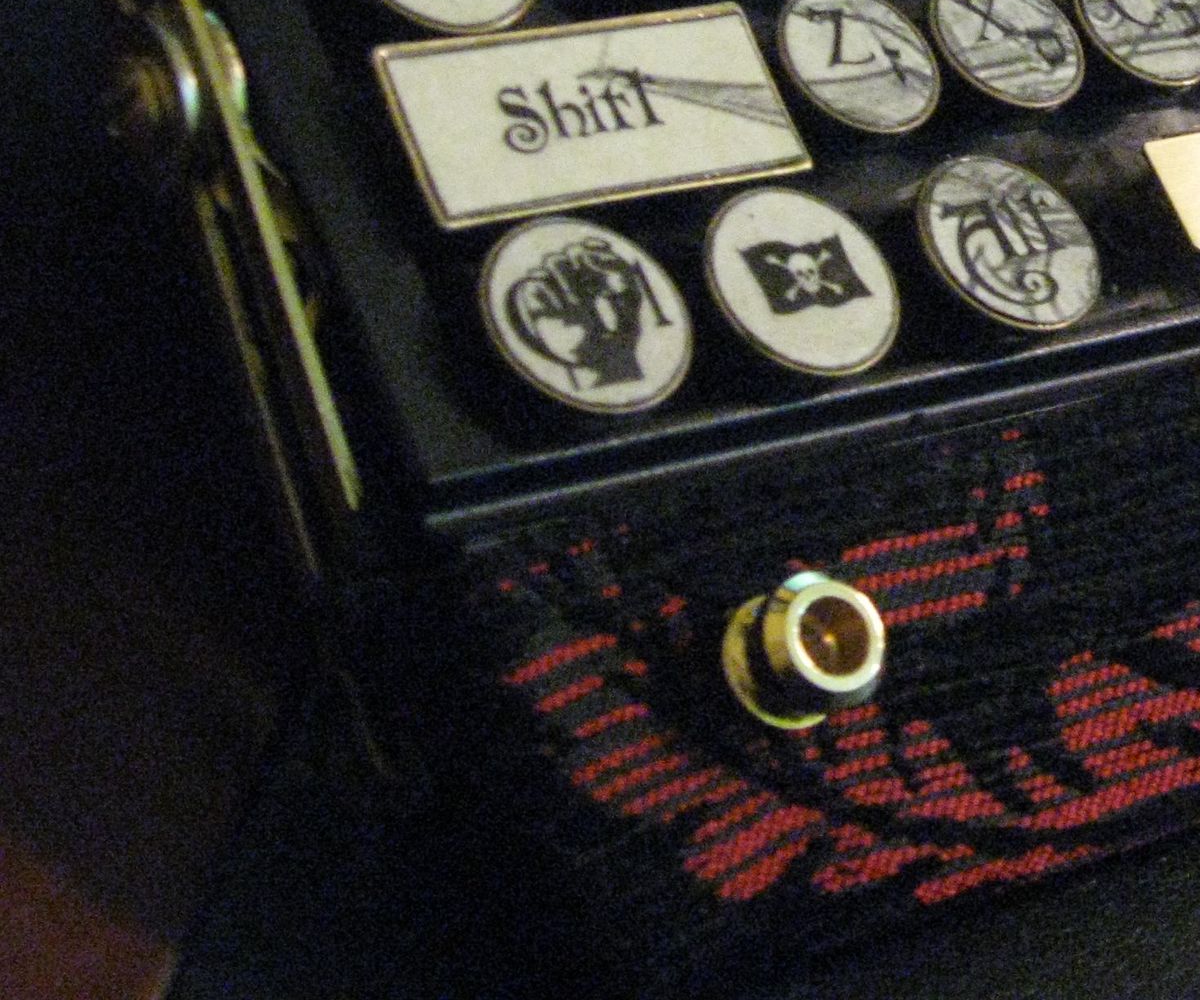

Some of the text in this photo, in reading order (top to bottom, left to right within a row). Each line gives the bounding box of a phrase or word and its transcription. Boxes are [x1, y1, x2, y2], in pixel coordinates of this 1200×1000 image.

[805, 6, 875, 67] Z
[496, 67, 665, 154] Shift
[936, 196, 1059, 304] Alt
